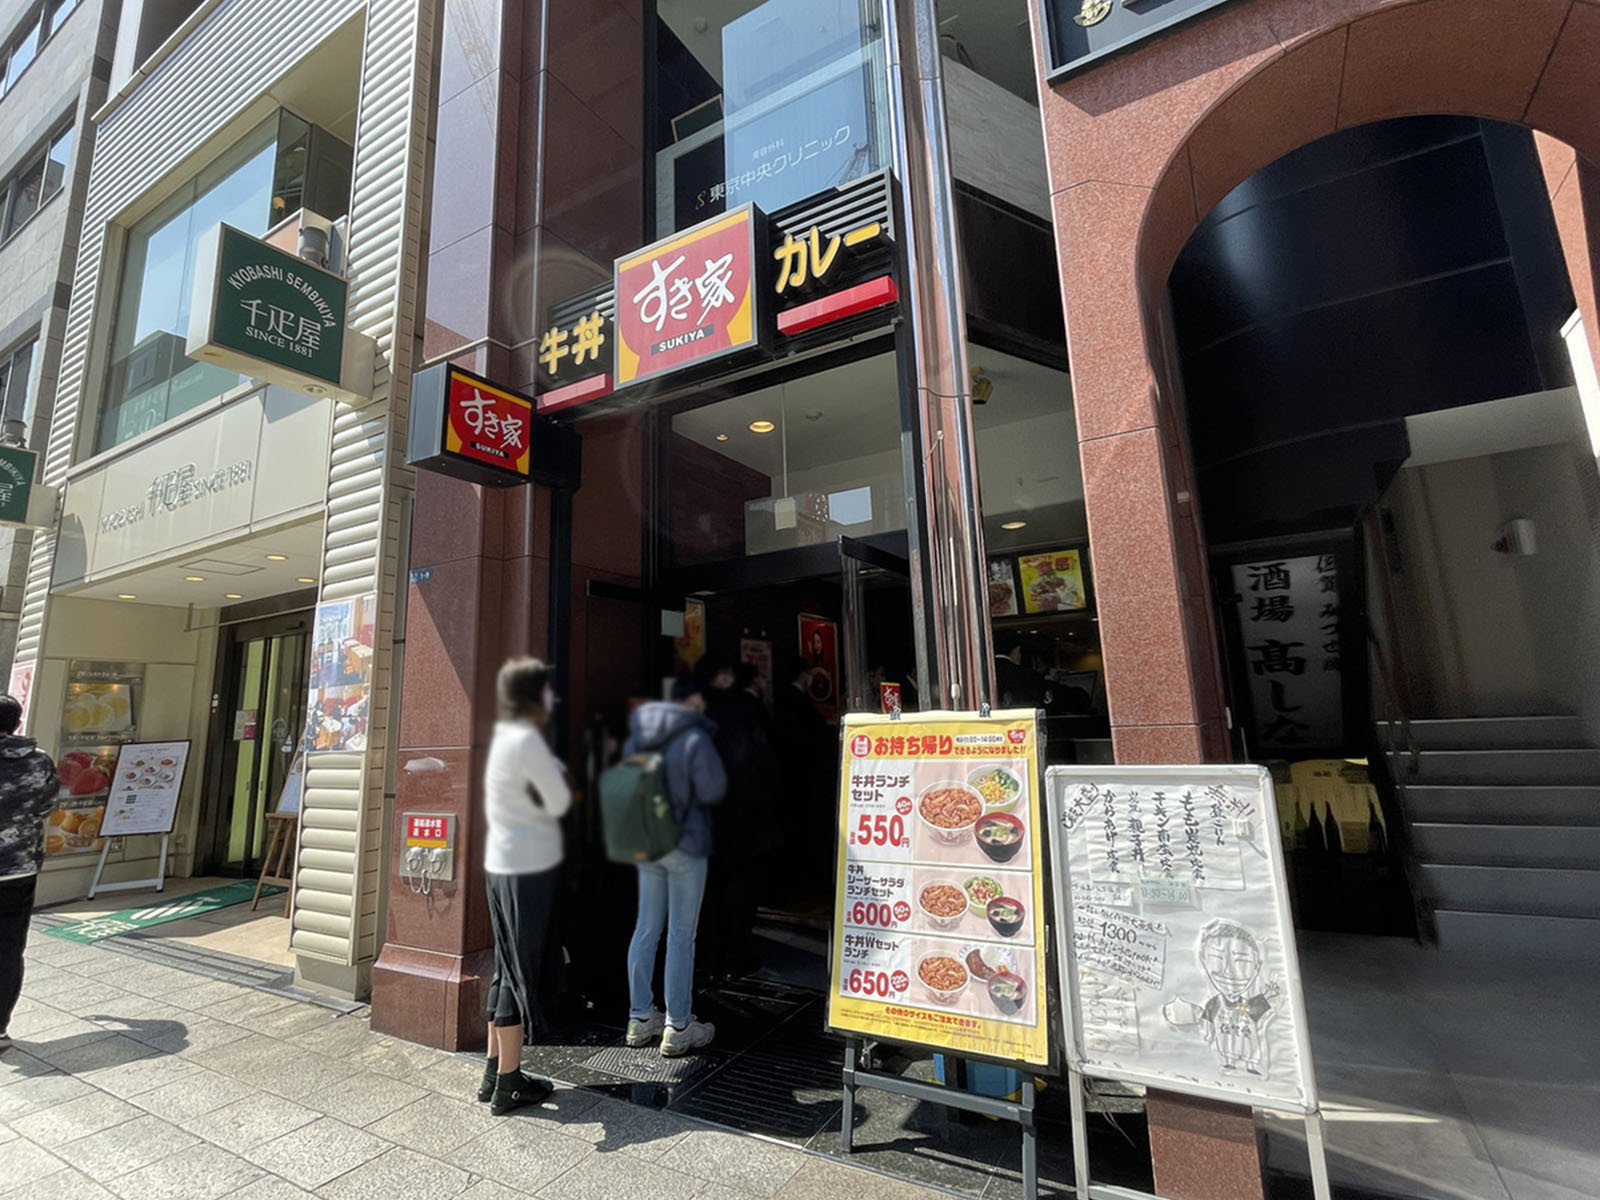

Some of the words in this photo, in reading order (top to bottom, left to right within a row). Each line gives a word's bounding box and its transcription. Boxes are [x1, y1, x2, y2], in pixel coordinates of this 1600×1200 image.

[710, 125, 851, 203] 東京中央クリニック
[775, 221, 883, 295] カレー
[227, 265, 283, 290] KYOBASHI
[286, 272, 337, 328] SEMBIKIYA
[633, 255, 735, 332] すき家
[240, 299, 321, 350] 千疋屋
[245, 325, 286, 349] SINCE
[289, 342, 313, 358] 1881
[539, 311, 606, 376] 牛丼
[658, 328, 706, 353] SUKIYA
[460, 388, 524, 450] すき家
[475, 443, 505, 459] SUKIYA
[1248, 562, 1293, 622] 酒場
[874, 735, 953, 757] お持ち帰り
[851, 775, 910, 788] 牛丼ランチ
[851, 788, 884, 802] セット
[847, 864, 864, 875] 牛丼
[847, 875, 905, 888] シーザーサラダ
[847, 885, 894, 898] ランチセット
[844, 934, 899, 951] 牛丼Wセット
[1099, 920, 1137, 944] 1300
[844, 947, 869, 959] ランチ
